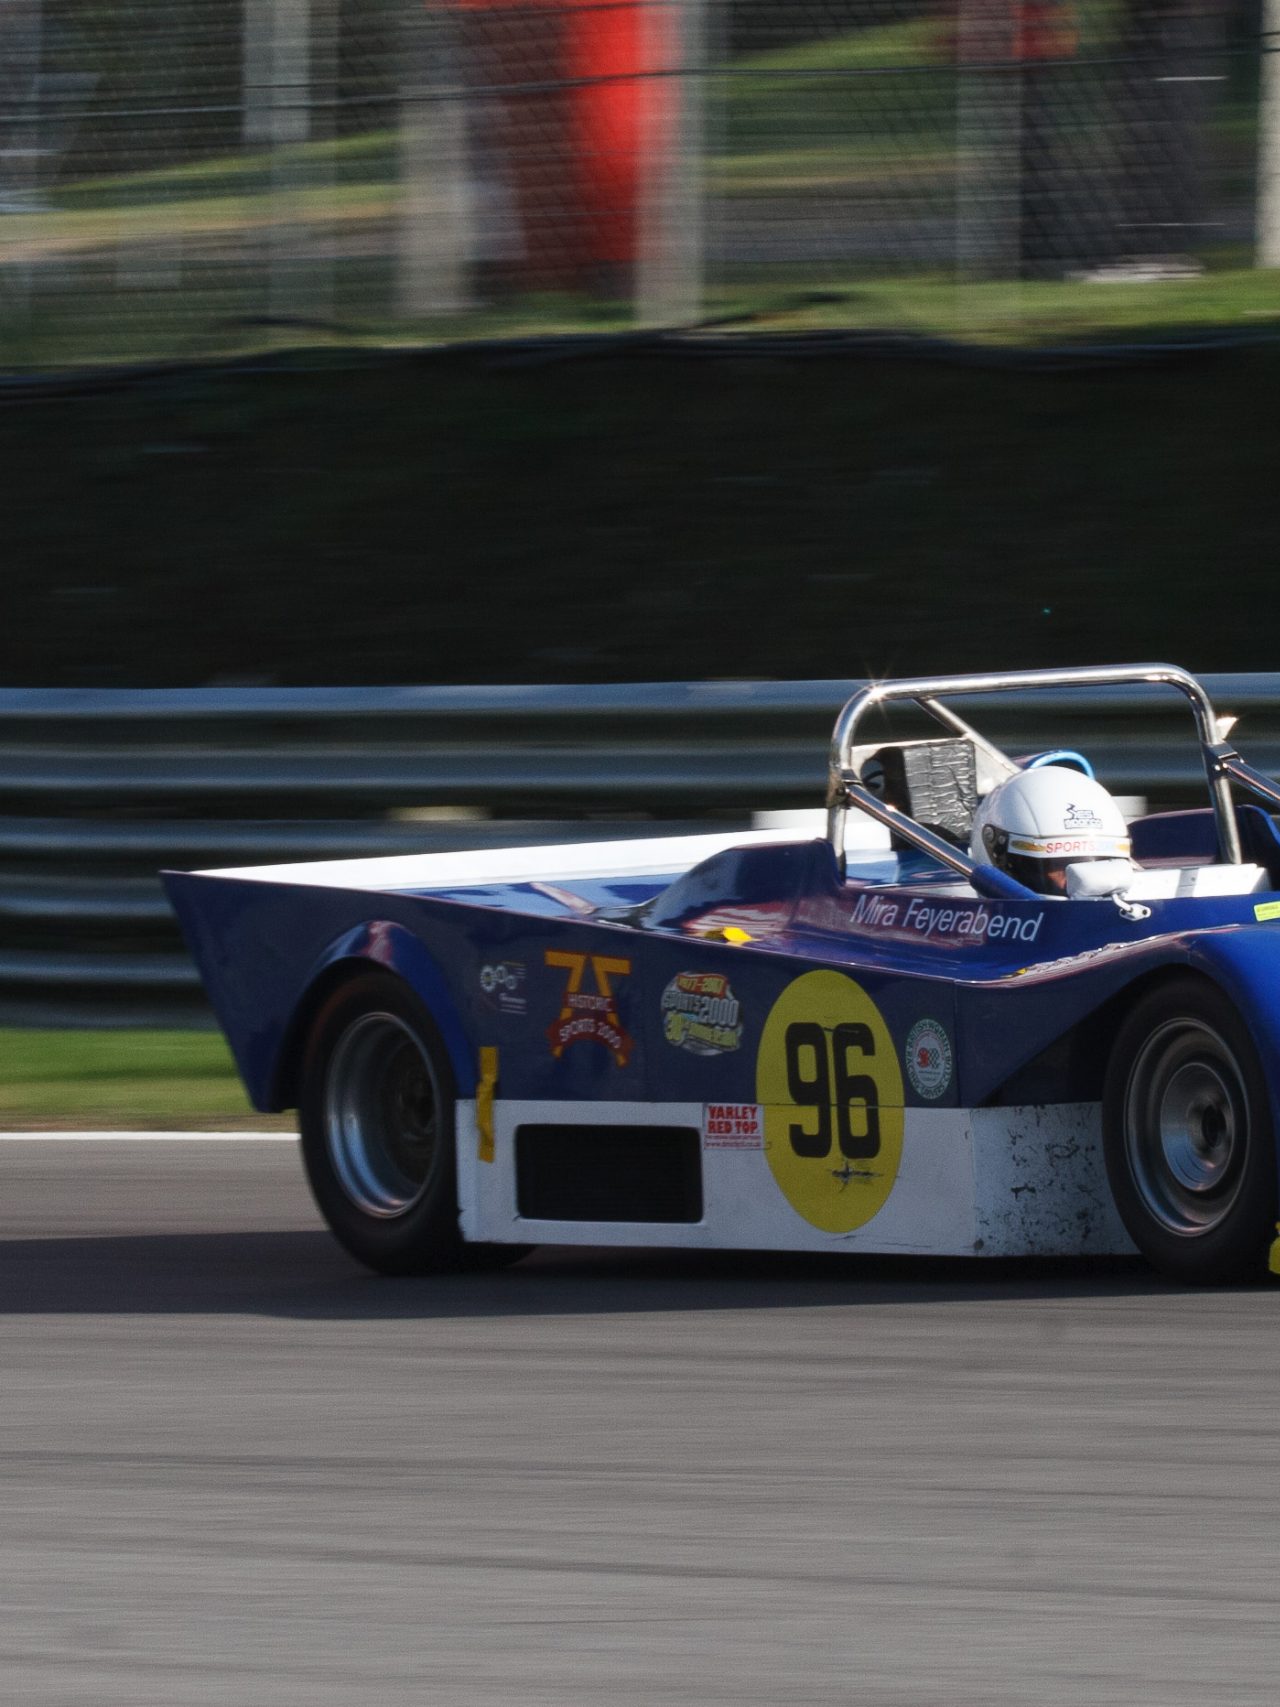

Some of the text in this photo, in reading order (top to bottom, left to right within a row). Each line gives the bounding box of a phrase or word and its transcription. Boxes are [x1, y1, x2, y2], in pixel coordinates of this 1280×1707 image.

[1046, 841, 1096, 854] SPORTS
[850, 894, 1044, 942] Mira Feyerabend
[785, 1022, 881, 1159] 96
[708, 1105, 758, 1119] VARLEY
[707, 1120, 758, 1135] RED TOP
